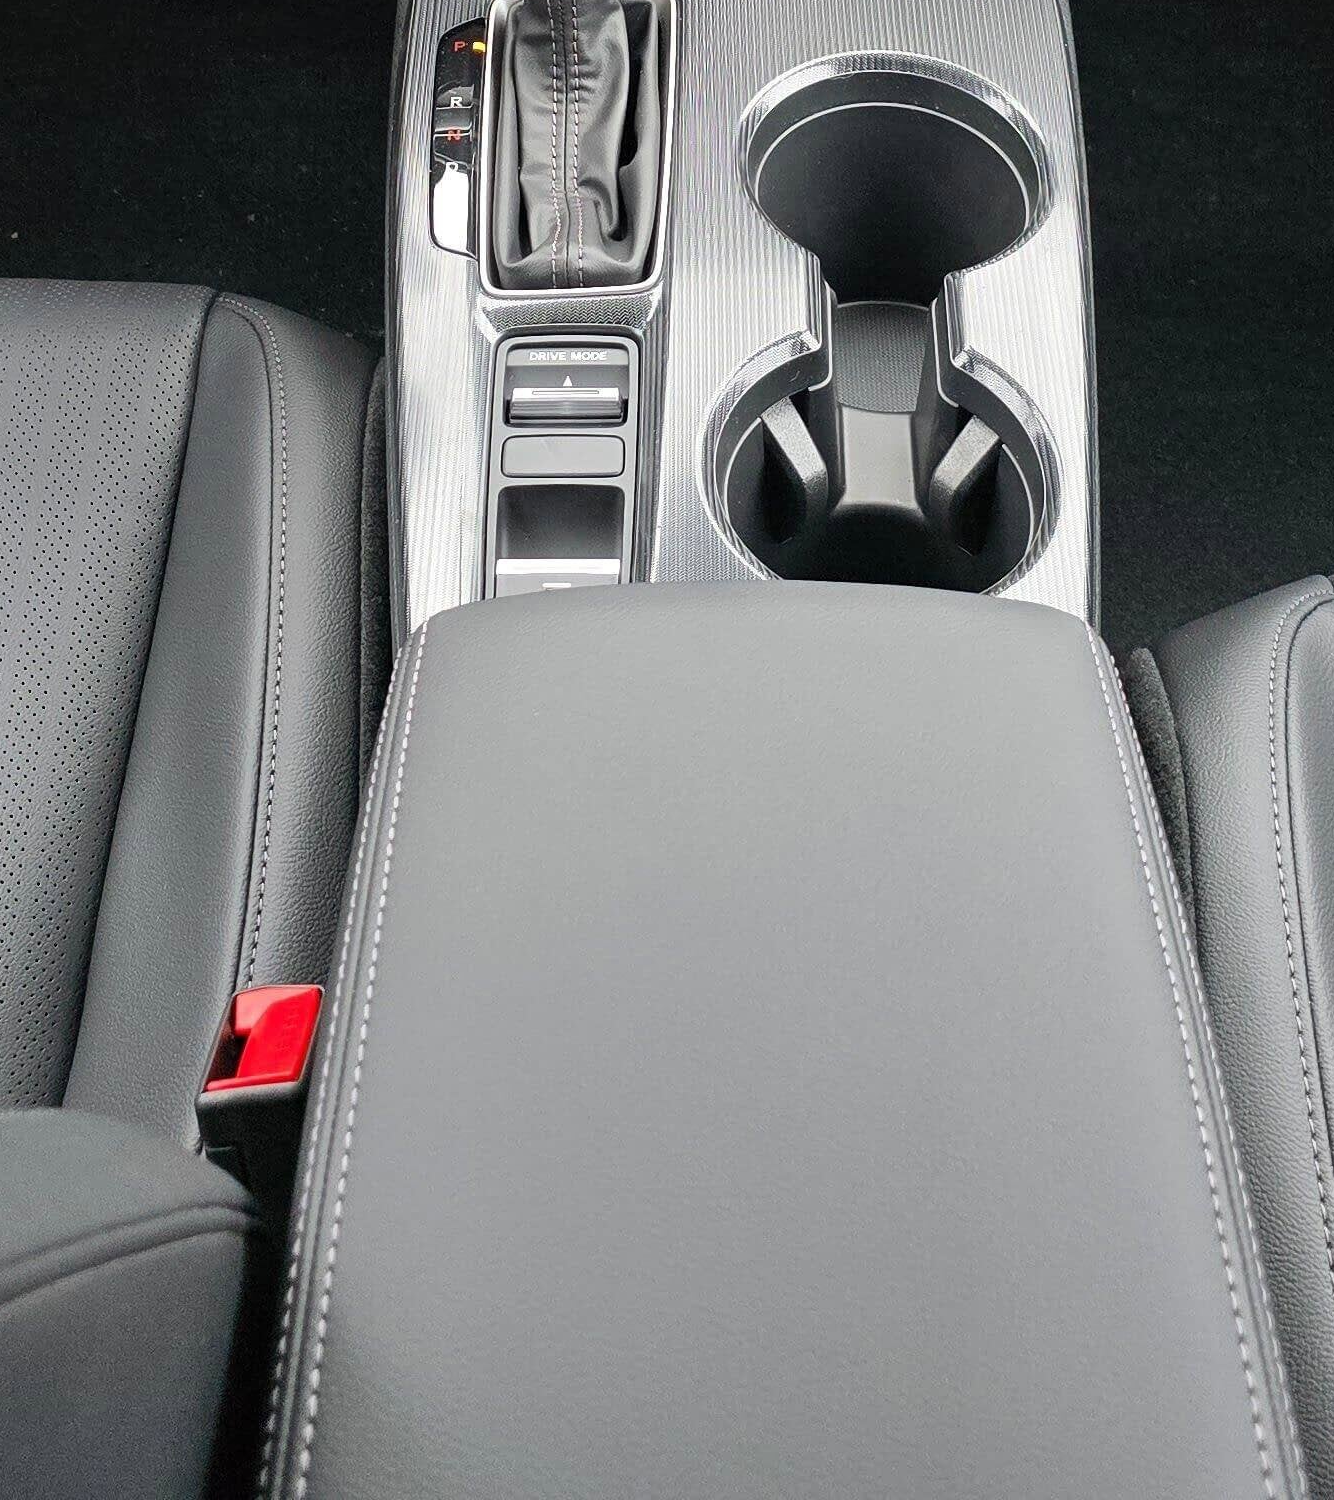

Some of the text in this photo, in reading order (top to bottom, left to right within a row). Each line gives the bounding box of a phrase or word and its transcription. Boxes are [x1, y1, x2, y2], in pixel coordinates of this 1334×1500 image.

[454, 41, 466, 52] P
[450, 96, 463, 107] R
[529, 351, 608, 361] DRIVE MODE
